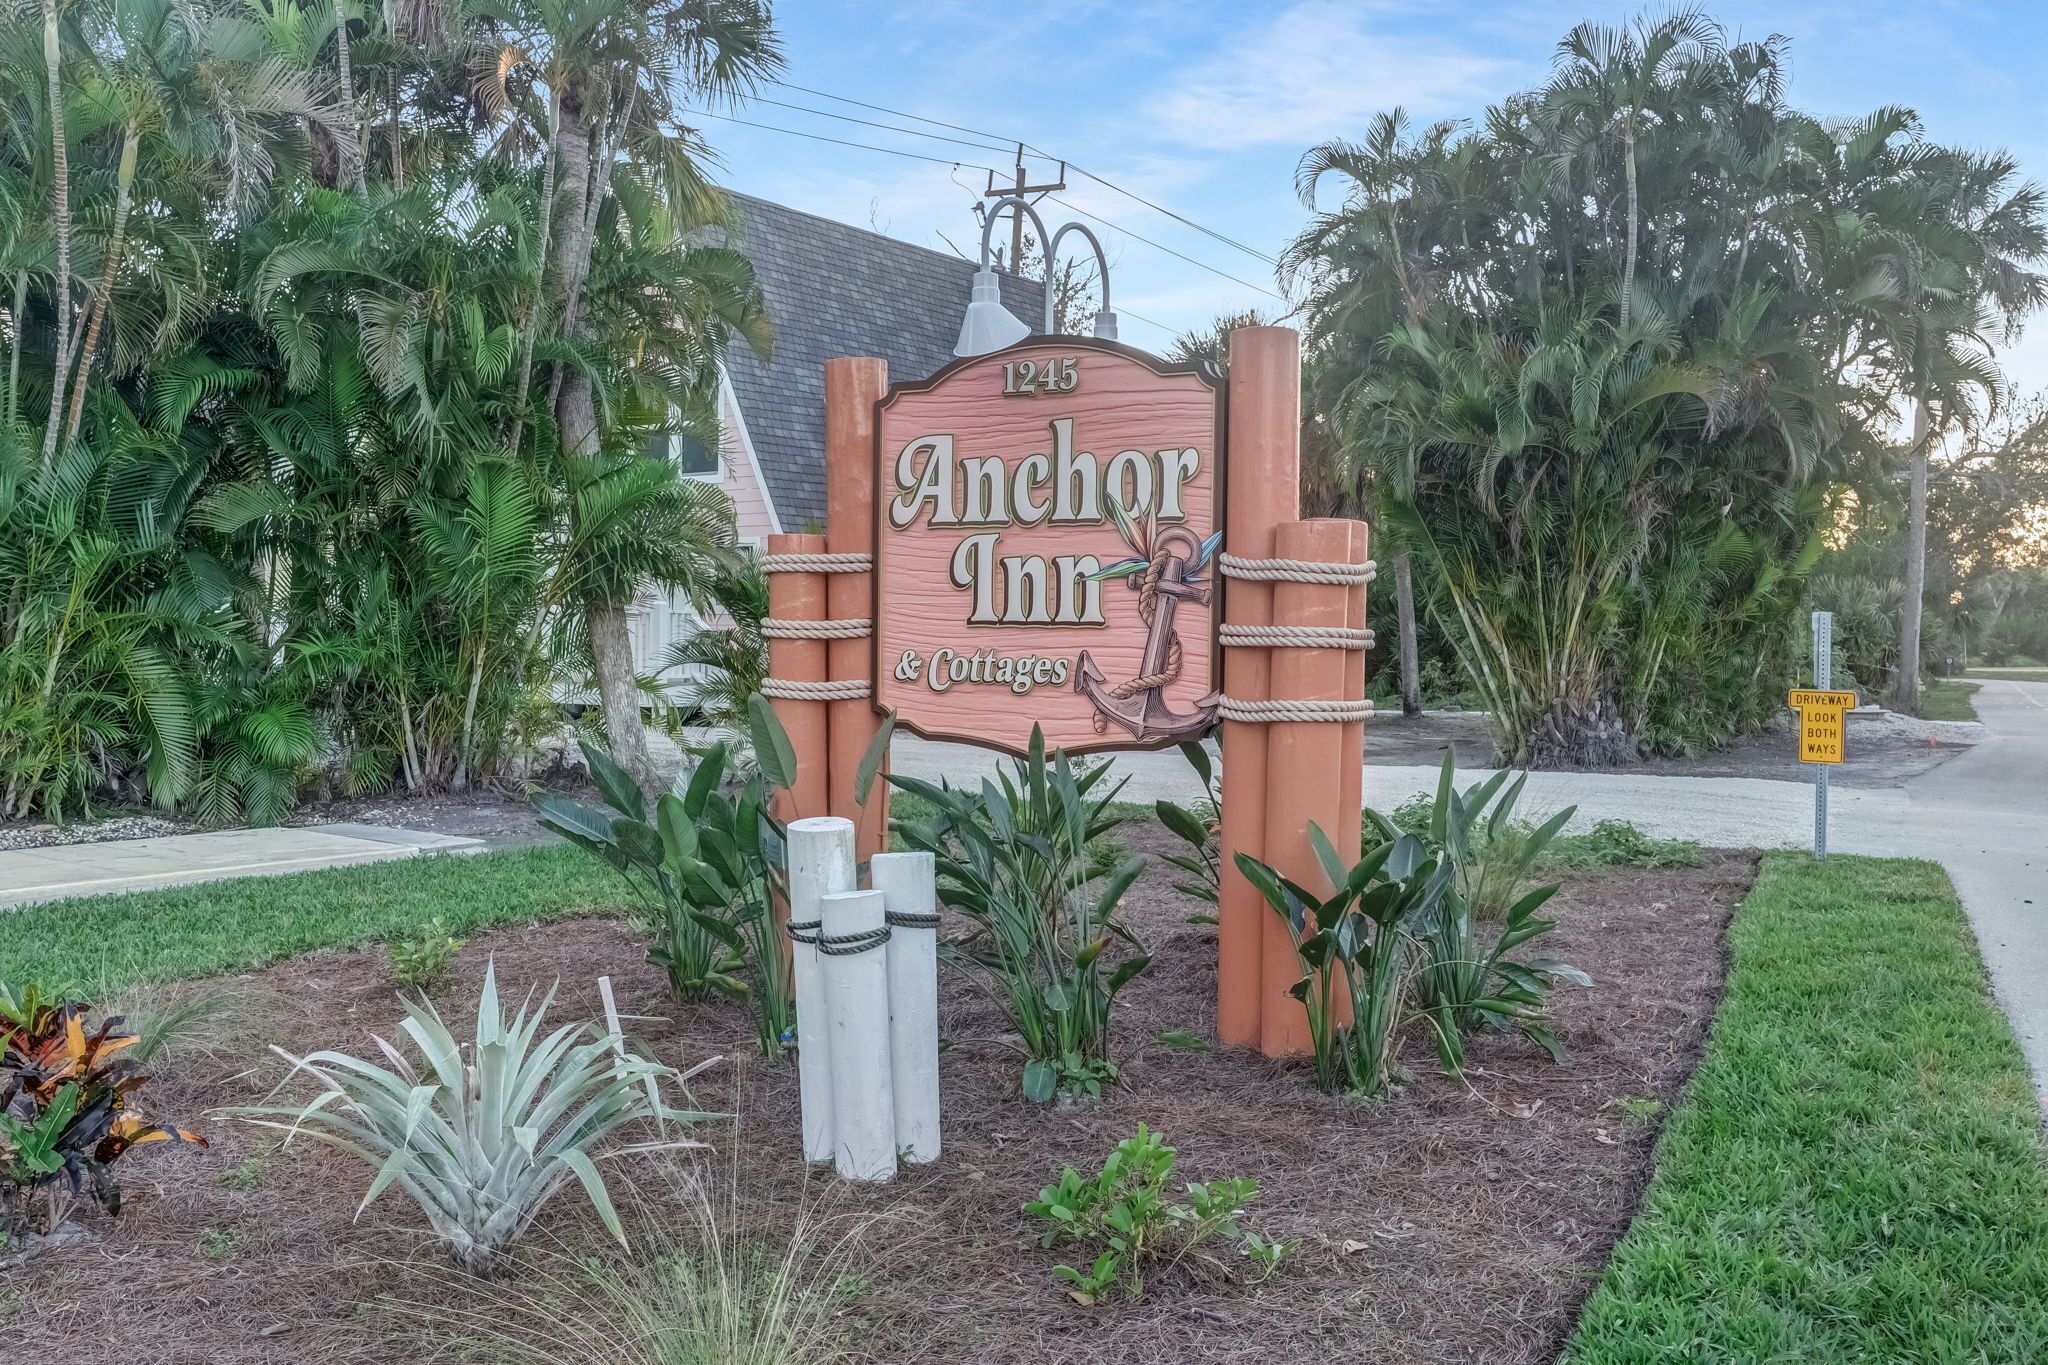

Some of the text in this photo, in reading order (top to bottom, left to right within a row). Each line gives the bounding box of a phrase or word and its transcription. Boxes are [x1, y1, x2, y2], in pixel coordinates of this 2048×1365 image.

[1002, 357, 1079, 396] 1245
[888, 417, 1200, 530] Anchor
[950, 532, 1107, 628] Inn
[893, 648, 1069, 696] & Cottages
[1796, 694, 1849, 706] DRIVEWAY
[1807, 712, 1837, 723] LOOK
[1807, 727, 1837, 739] BOTH
[1807, 743, 1836, 755] WAYS
